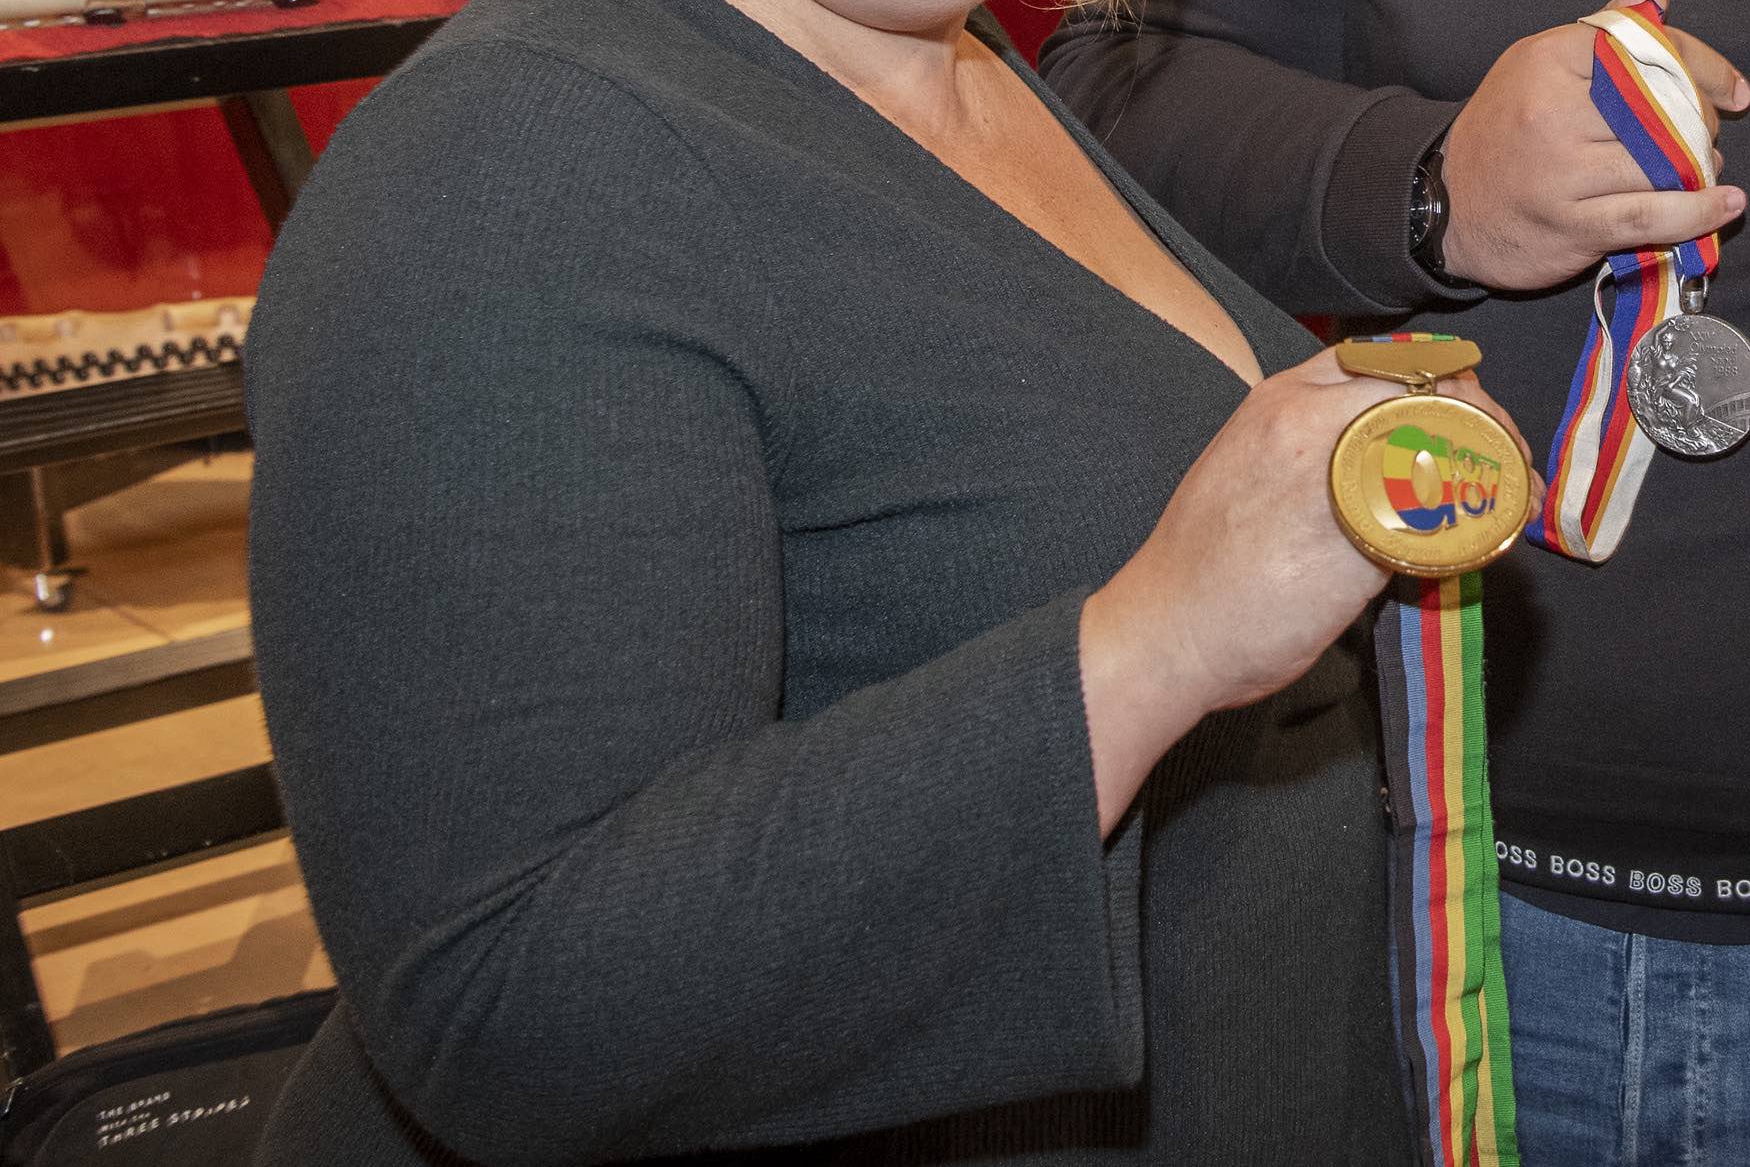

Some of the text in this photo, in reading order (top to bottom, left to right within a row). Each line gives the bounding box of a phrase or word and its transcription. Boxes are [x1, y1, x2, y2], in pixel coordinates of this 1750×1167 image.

[1495, 840, 1537, 869] OSS
[1550, 854, 1616, 884] BOSS
[1629, 870, 1702, 897] BOSS
